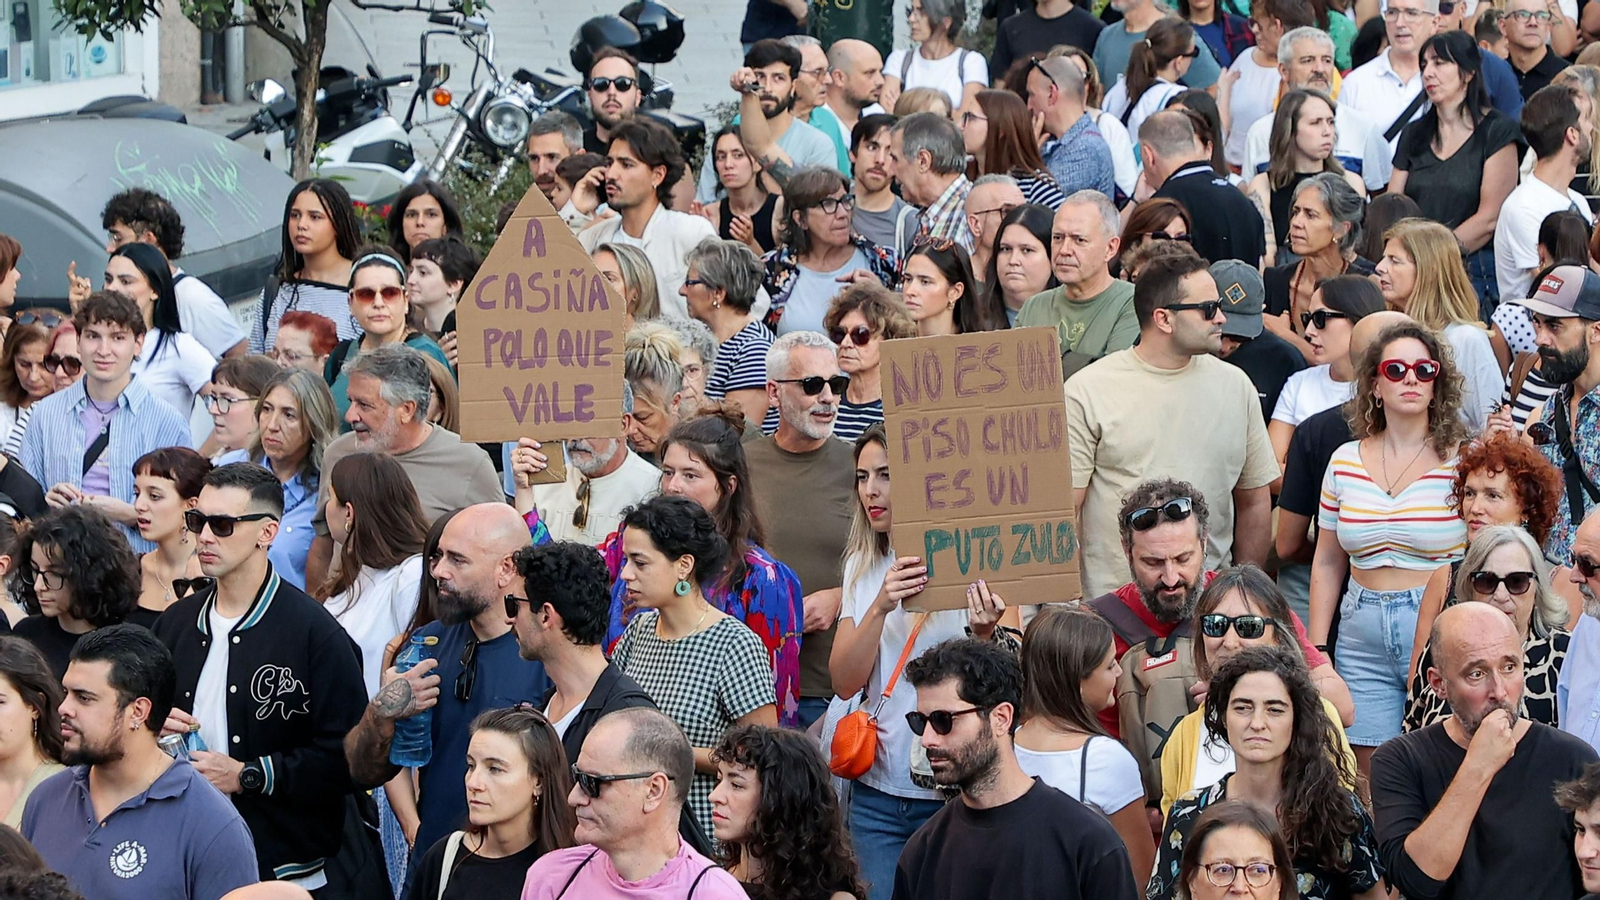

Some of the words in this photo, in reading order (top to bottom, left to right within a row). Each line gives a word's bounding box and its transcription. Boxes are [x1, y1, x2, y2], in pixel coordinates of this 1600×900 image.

[522, 217, 547, 258] A
[483, 326, 548, 371] POLO
[556, 328, 614, 368] QUE
[889, 348, 944, 407] NO
[954, 342, 1009, 398] ES
[1017, 334, 1057, 394] UN
[502, 381, 596, 426] VALE
[982, 407, 1063, 455] CHULO
[923, 468, 976, 512] ES
[986, 461, 1029, 507] UN
[923, 524, 1004, 578] PUTO
[1010, 520, 1077, 566] ZULO
[113, 840, 130, 853] LIFE
